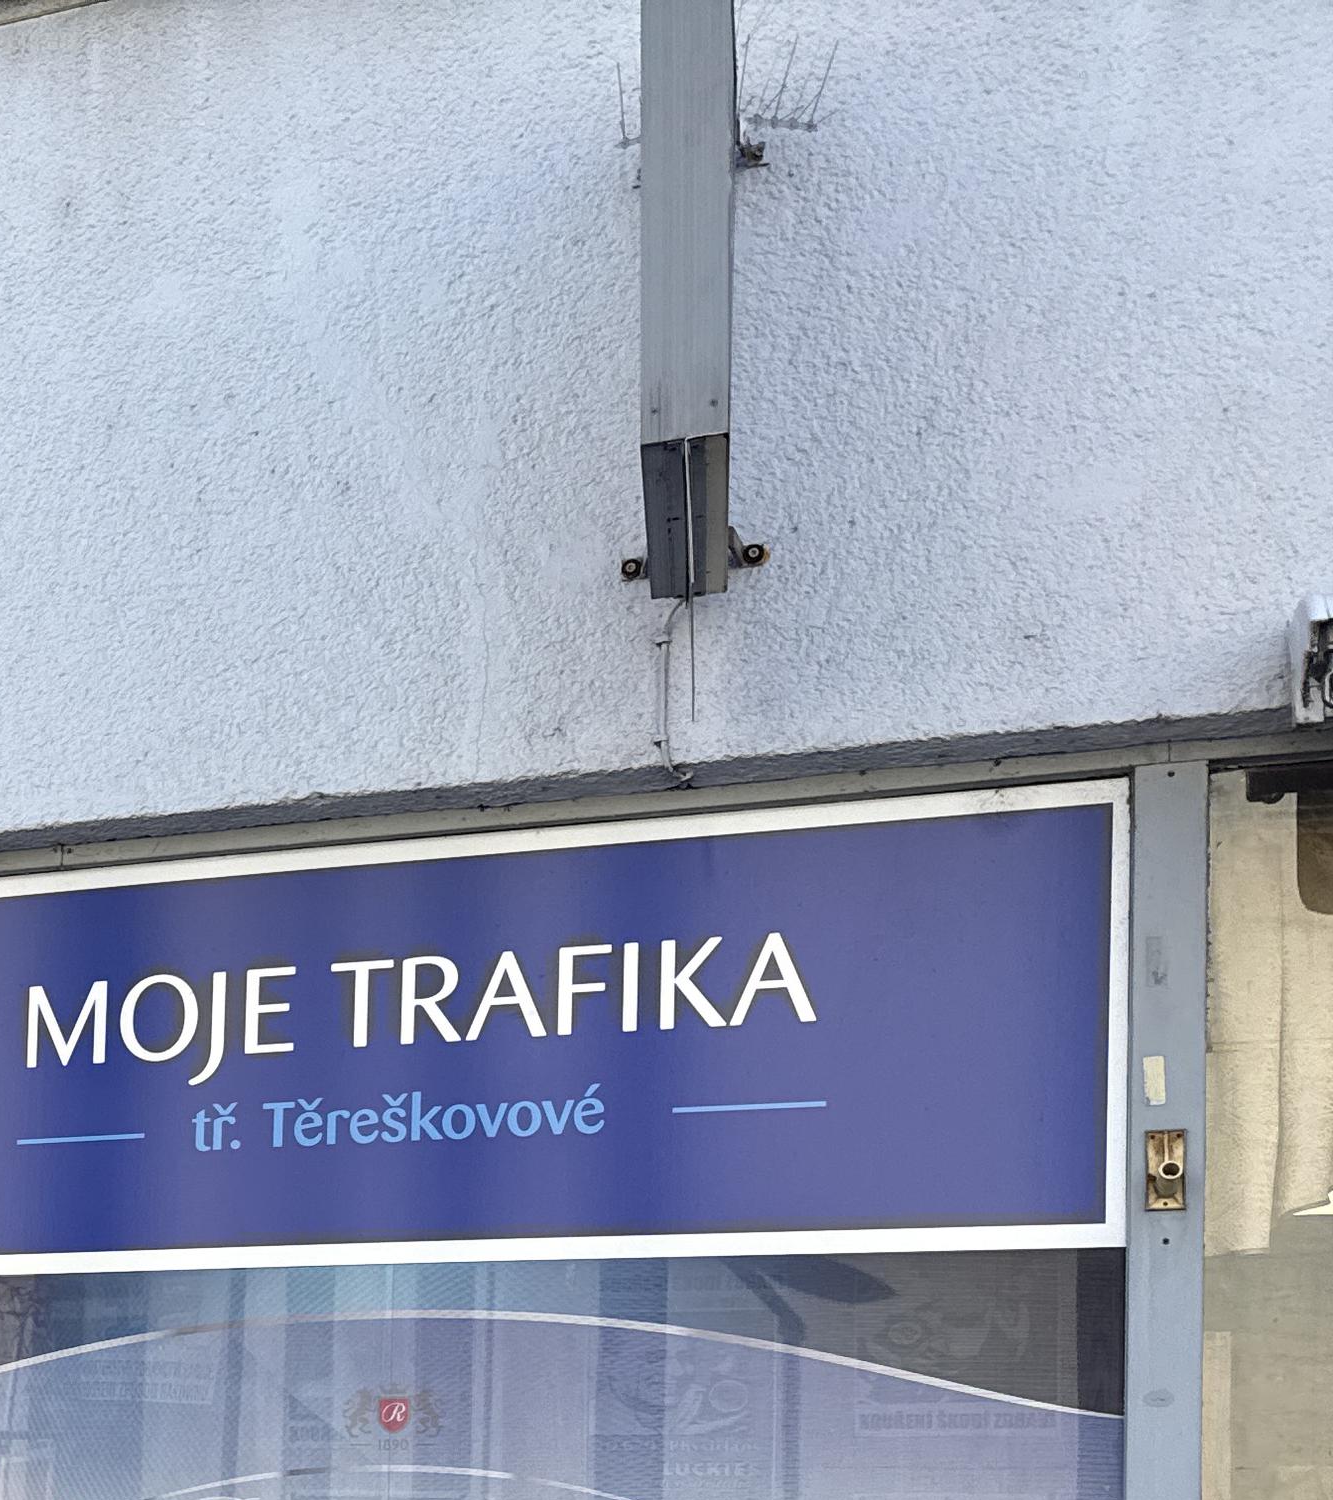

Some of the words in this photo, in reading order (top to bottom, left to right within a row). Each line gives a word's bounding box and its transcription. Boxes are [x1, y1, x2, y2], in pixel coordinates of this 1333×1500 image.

[24, 965, 297, 1087] MOJE
[331, 931, 818, 1049] TRAFIKA
[192, 1104, 241, 1153] tř.
[263, 1082, 607, 1153] Těreškovové
